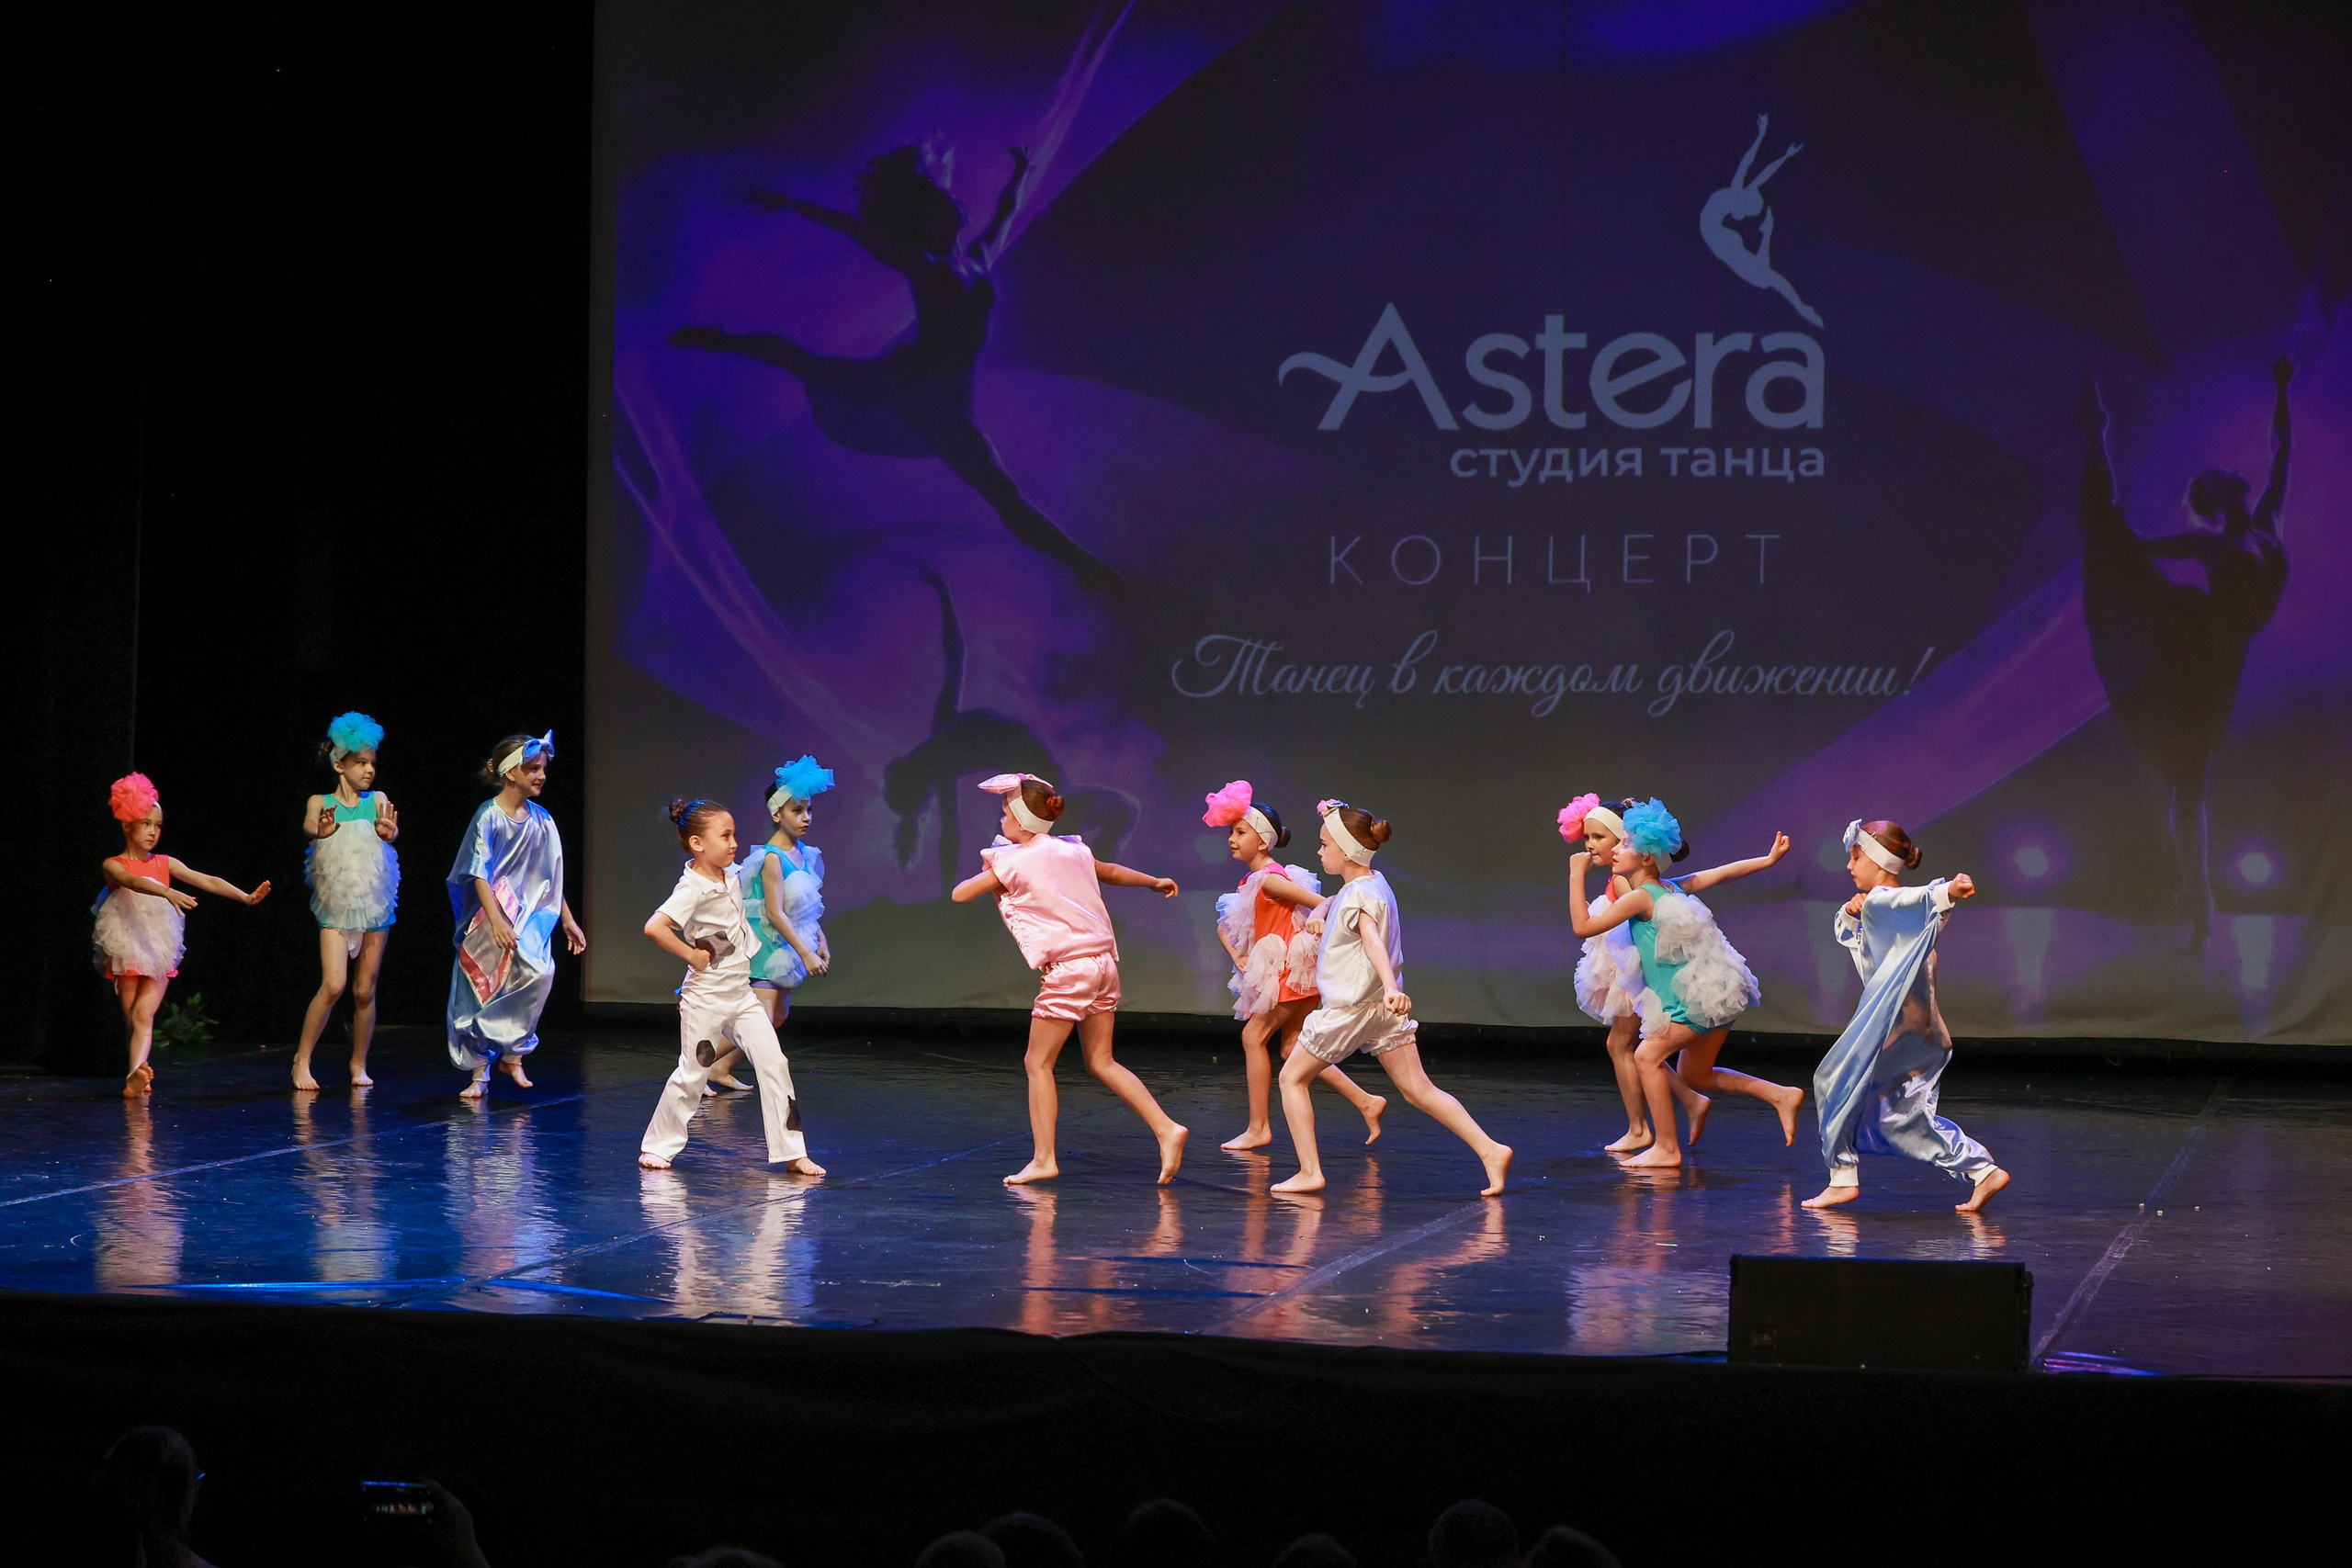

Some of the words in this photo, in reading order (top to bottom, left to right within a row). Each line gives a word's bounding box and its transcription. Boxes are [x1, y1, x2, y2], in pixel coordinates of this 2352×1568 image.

[1278, 302, 1826, 431] Astera
[1450, 446, 1643, 488] студия
[1659, 446, 1826, 483] танца
[1329, 534, 1782, 593] КОНЦЕРТ
[1170, 634, 1376, 709] Танец
[1387, 629, 1440, 695] в
[1432, 657, 1644, 718] каждом
[1646, 629, 1936, 718] движении!
